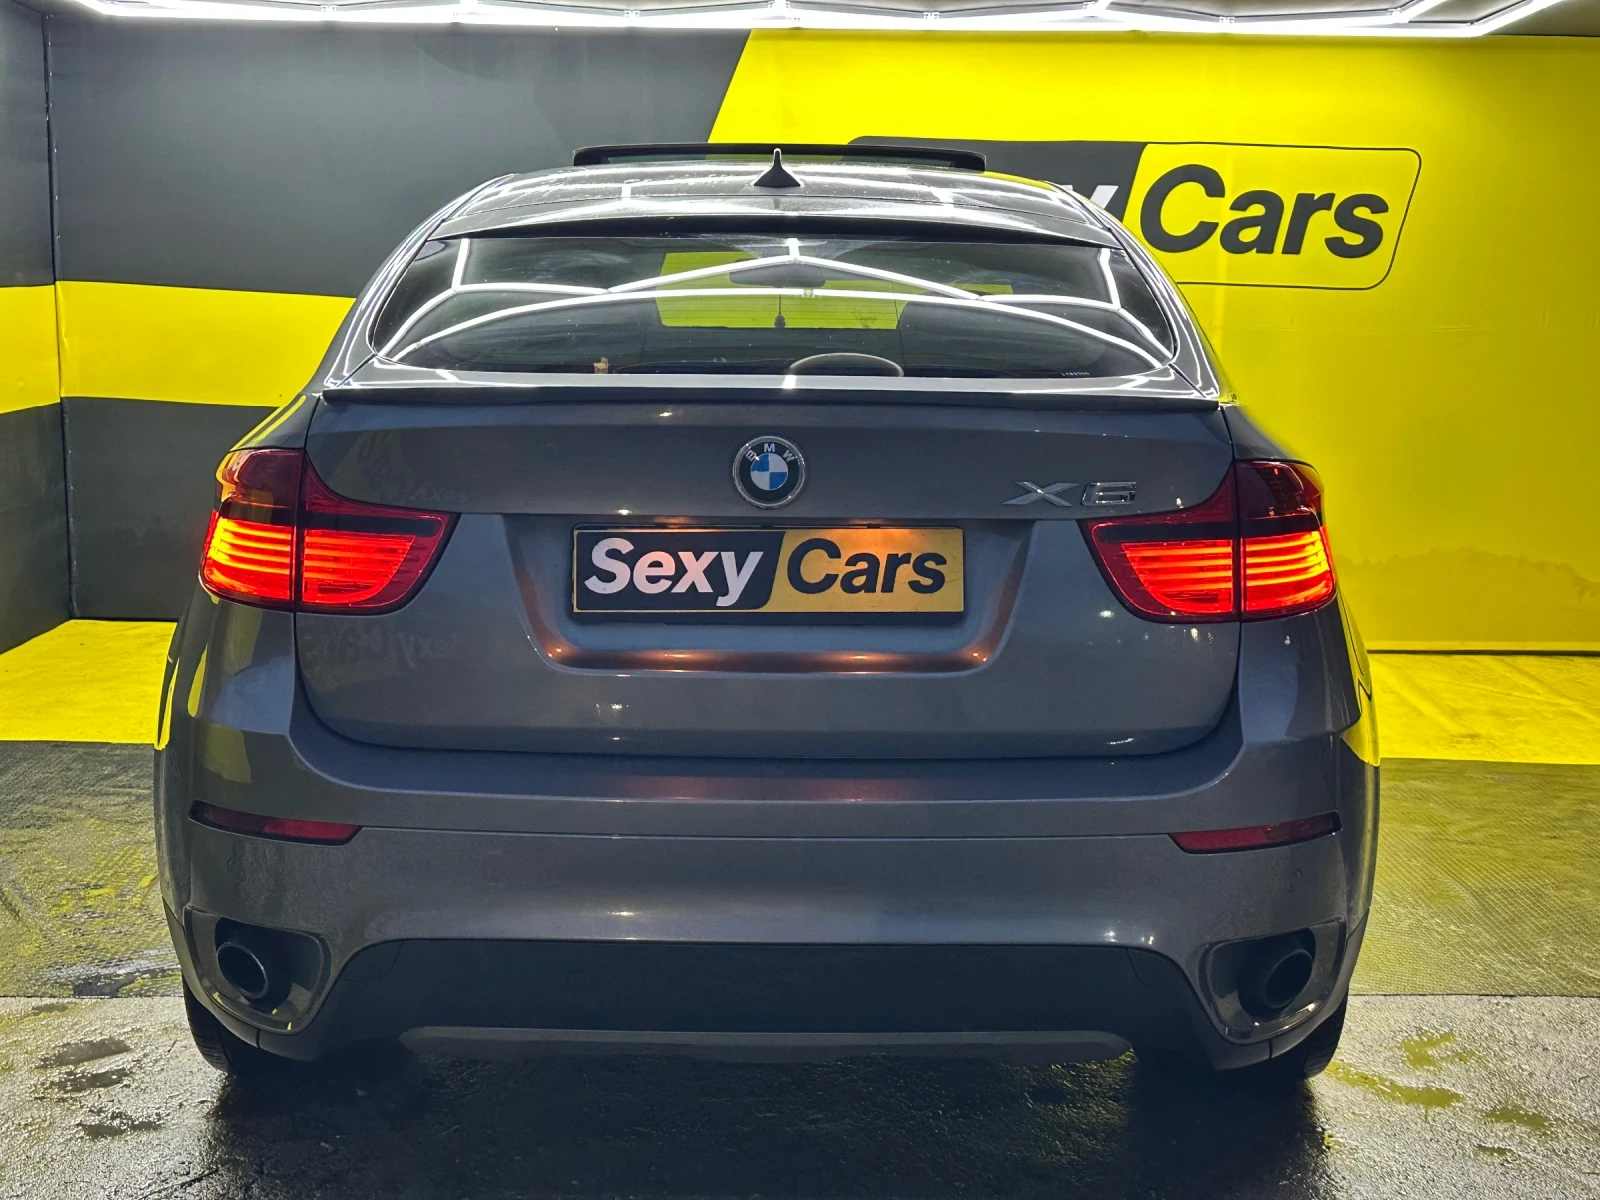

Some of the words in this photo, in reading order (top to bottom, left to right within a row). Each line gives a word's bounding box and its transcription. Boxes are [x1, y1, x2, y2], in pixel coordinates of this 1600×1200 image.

[1140, 163, 1389, 259] Cars
[745, 443, 795, 462] BMW
[1002, 480, 1137, 507] X6
[584, 537, 763, 607] Sexy
[786, 537, 947, 594] Cars
